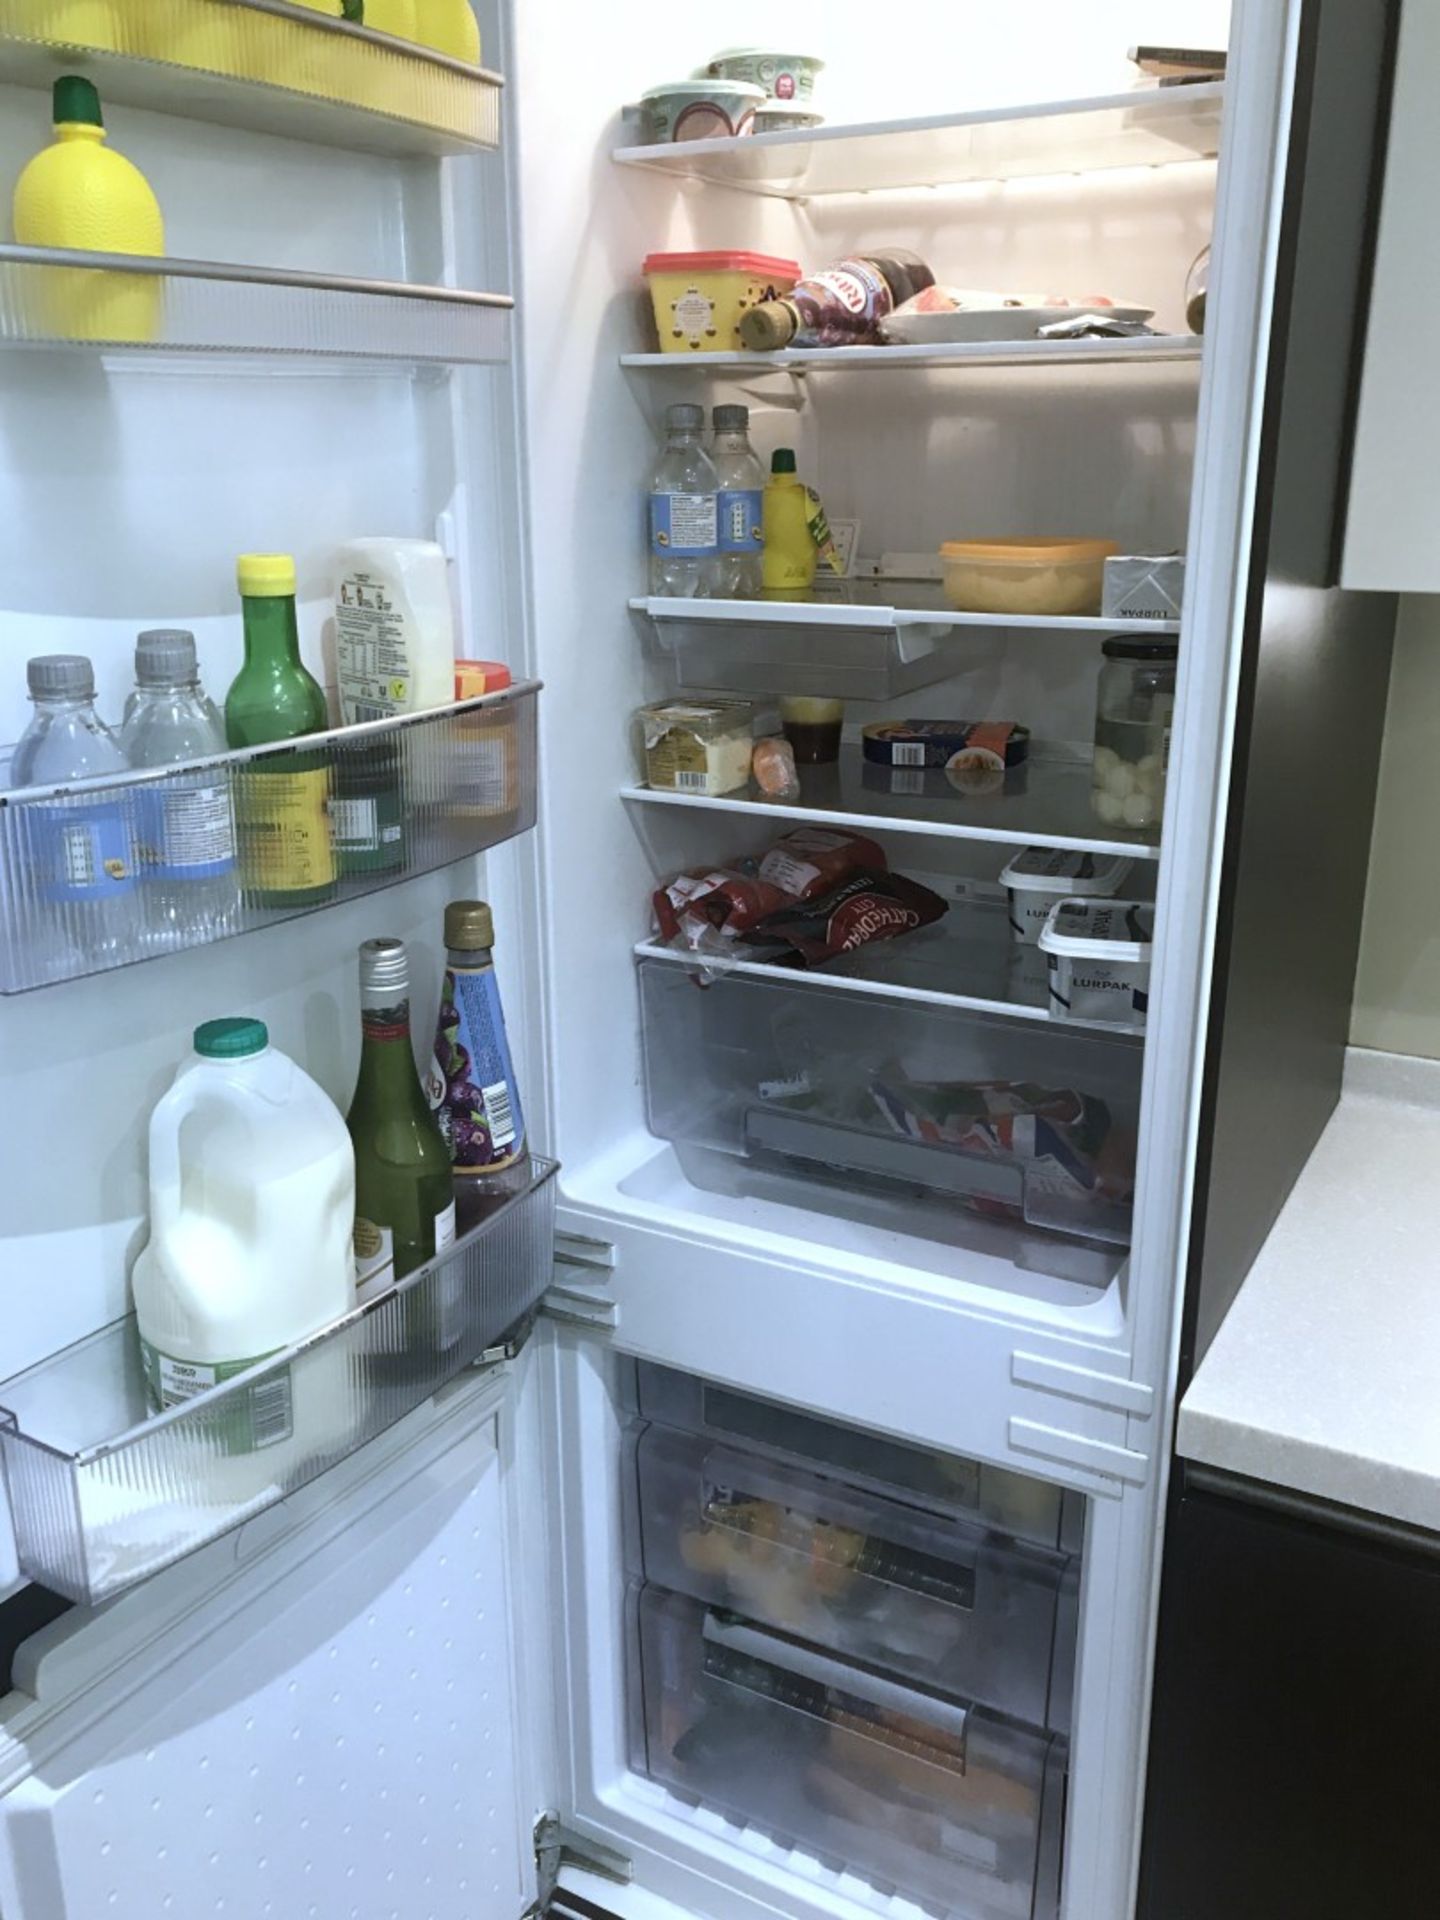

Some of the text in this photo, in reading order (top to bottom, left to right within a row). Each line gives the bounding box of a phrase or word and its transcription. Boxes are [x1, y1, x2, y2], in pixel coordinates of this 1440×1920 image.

[851, 899, 876, 914] CITY
[842, 907, 920, 950] CATHEDRAL
[1073, 977, 1132, 991] LURPAK
